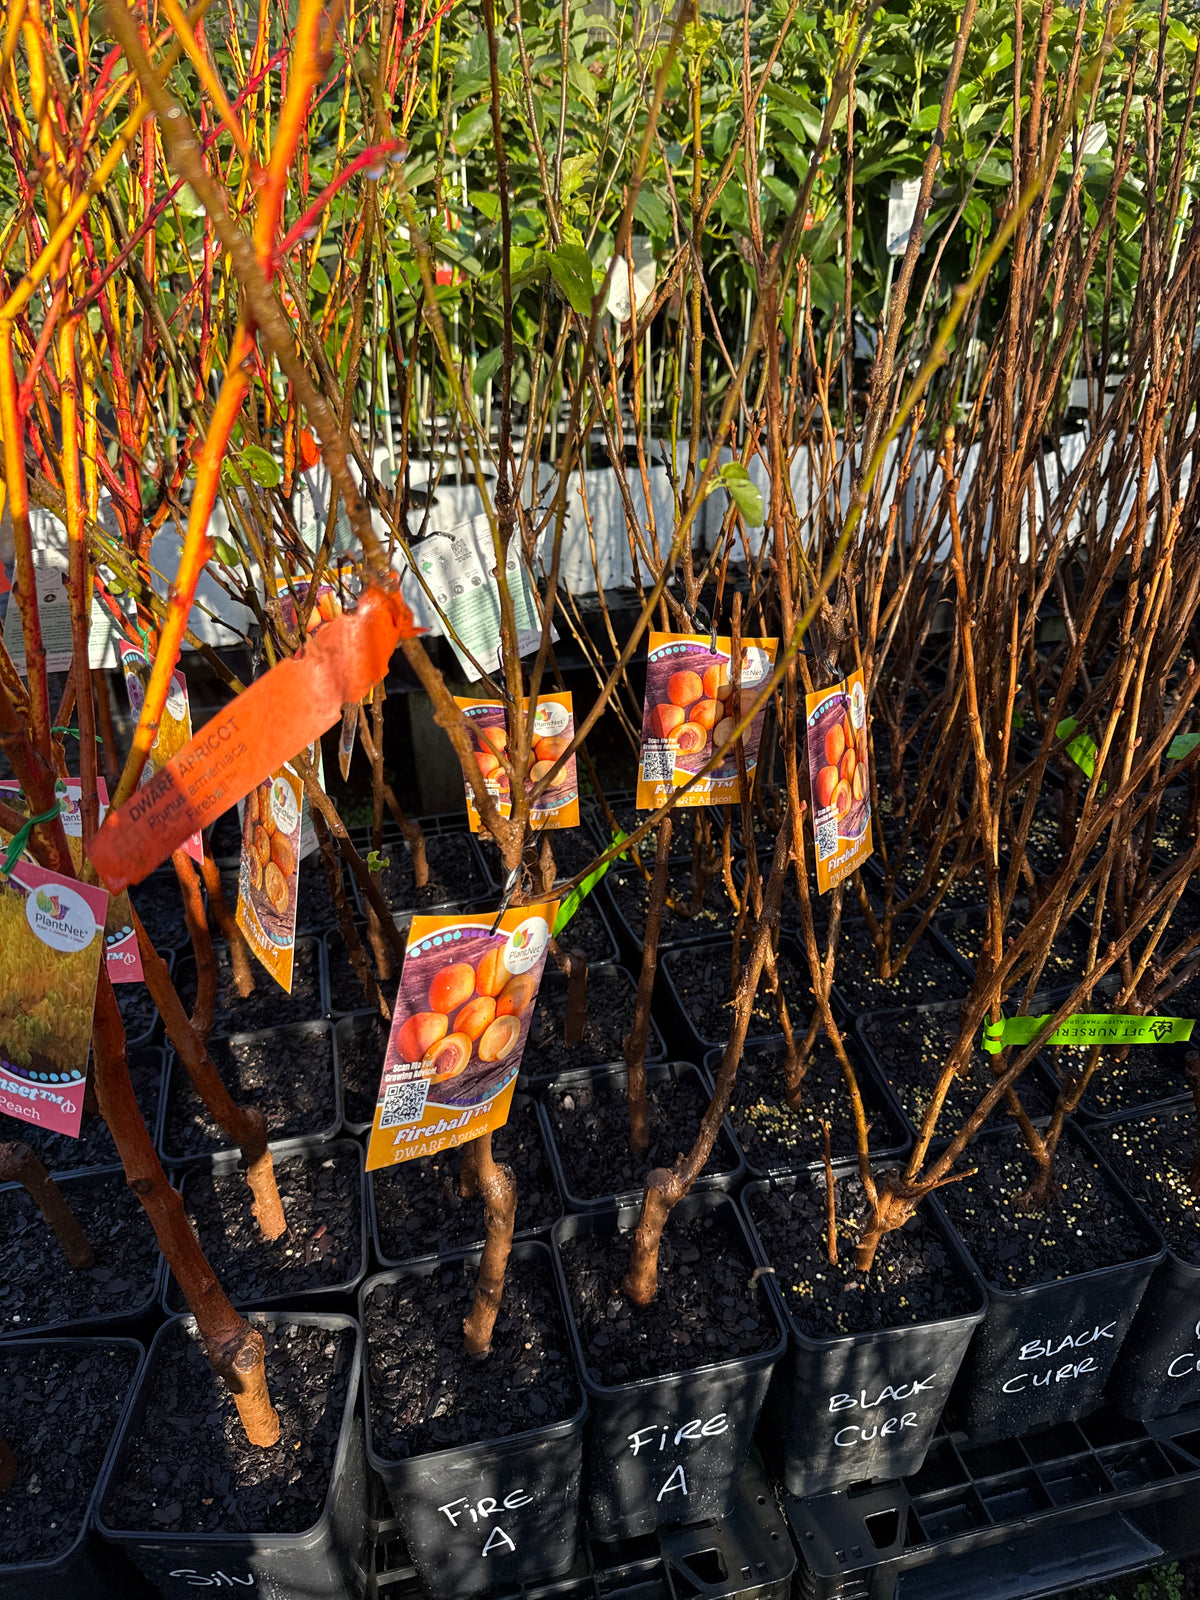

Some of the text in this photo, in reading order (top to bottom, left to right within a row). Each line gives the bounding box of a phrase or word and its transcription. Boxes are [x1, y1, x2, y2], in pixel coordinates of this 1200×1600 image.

[129, 716, 239, 822] DWARF APRICOT
[147, 793, 188, 829] Prunus
[1121, 1027, 1146, 1037] JFT
[385, 1071, 413, 1082] Growing
[393, 1064, 410, 1072] Scan
[411, 1062, 421, 1070] Me
[394, 1123, 489, 1162] DWARF Apricot
[1018, 1321, 1118, 1361] BLACK
[828, 1373, 937, 1413] BLACK
[1002, 1357, 1099, 1395] CURR
[833, 1412, 919, 1448] CURR
[656, 1464, 689, 1502] A
[481, 1526, 517, 1557] A
